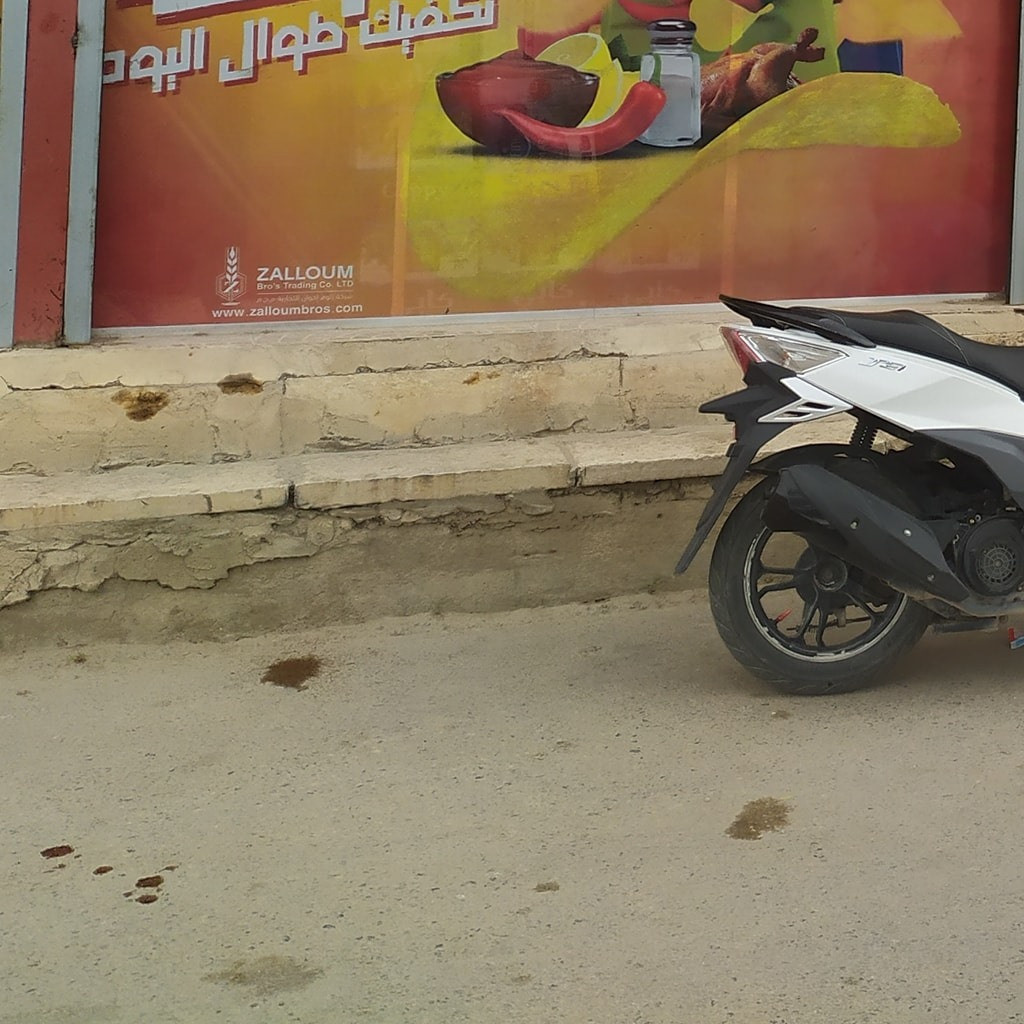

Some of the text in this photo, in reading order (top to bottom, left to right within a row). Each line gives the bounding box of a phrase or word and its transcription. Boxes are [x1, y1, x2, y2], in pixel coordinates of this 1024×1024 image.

[219, 11, 344, 83] طوال
[256, 265, 354, 282] ZALLOUM
[256, 282, 280, 291] Bro's
[283, 281, 317, 290] Trading
[336, 279, 354, 287] LTD
[211, 303, 363, 318] www.zalloumbros.com
